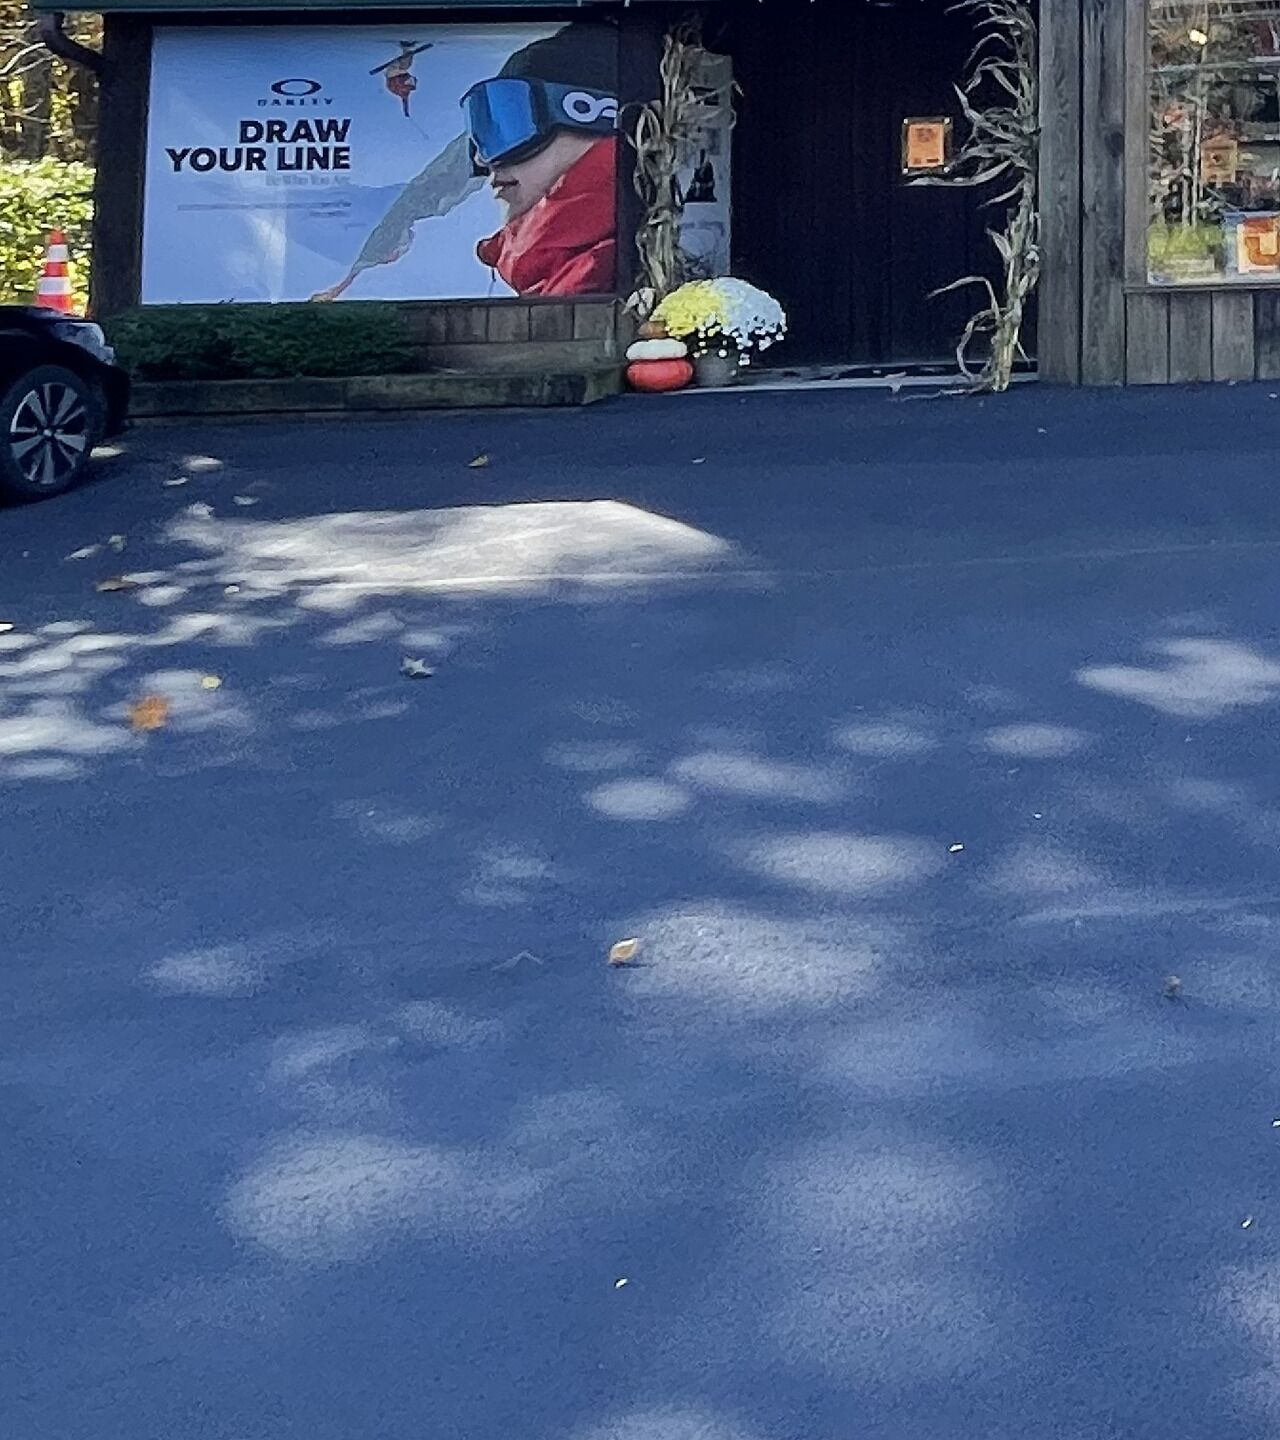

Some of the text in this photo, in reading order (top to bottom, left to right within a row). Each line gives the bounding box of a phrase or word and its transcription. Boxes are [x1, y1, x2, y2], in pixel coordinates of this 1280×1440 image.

[239, 119, 352, 143] DRAW
[165, 146, 352, 172] YOUR LINE
